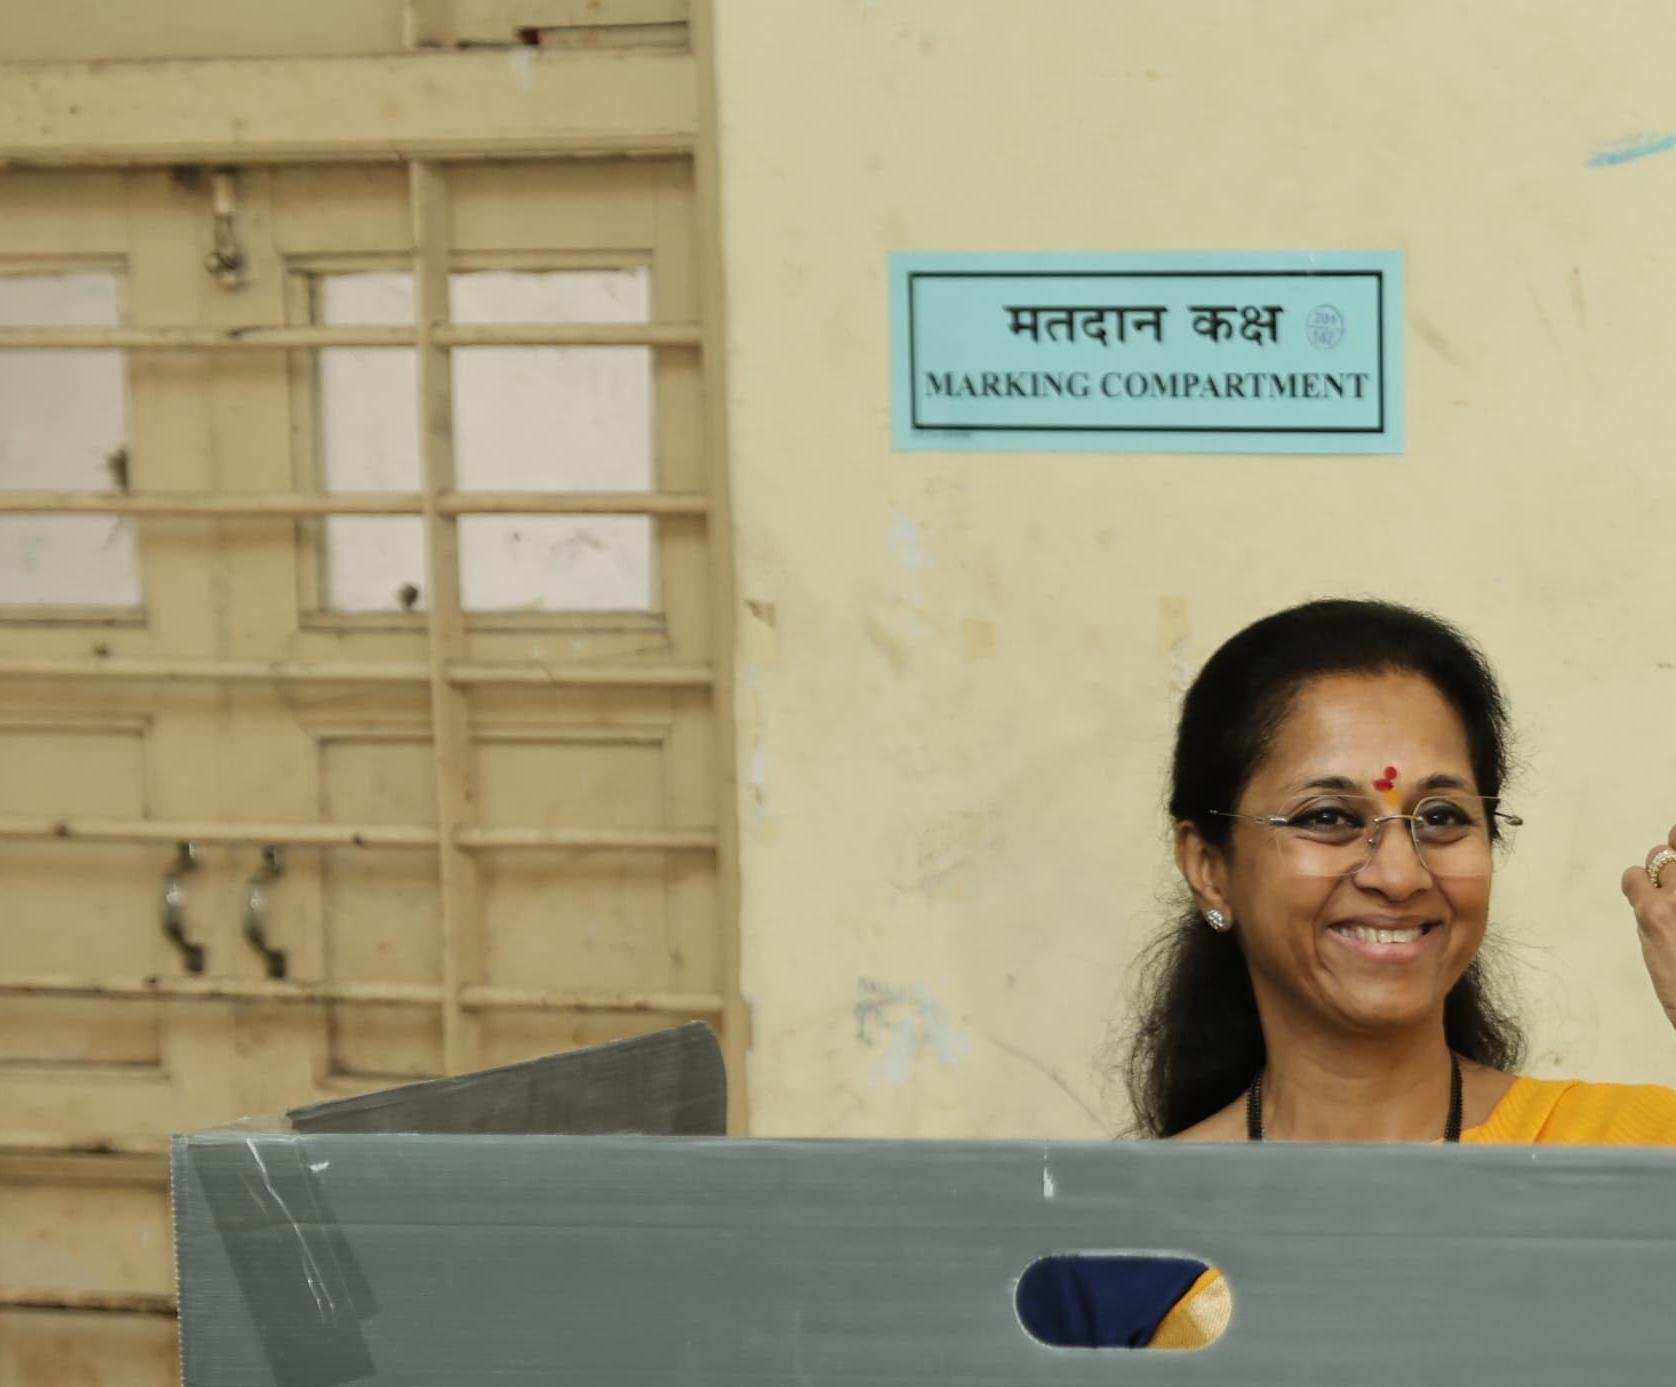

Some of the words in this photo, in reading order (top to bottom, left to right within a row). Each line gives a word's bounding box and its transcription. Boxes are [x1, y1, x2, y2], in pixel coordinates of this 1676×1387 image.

[1004, 305, 1169, 347] मतदान
[1188, 305, 1285, 346] कक्ष
[926, 372, 1089, 398] MARKING
[1100, 373, 1368, 399] COMPARTMENT
